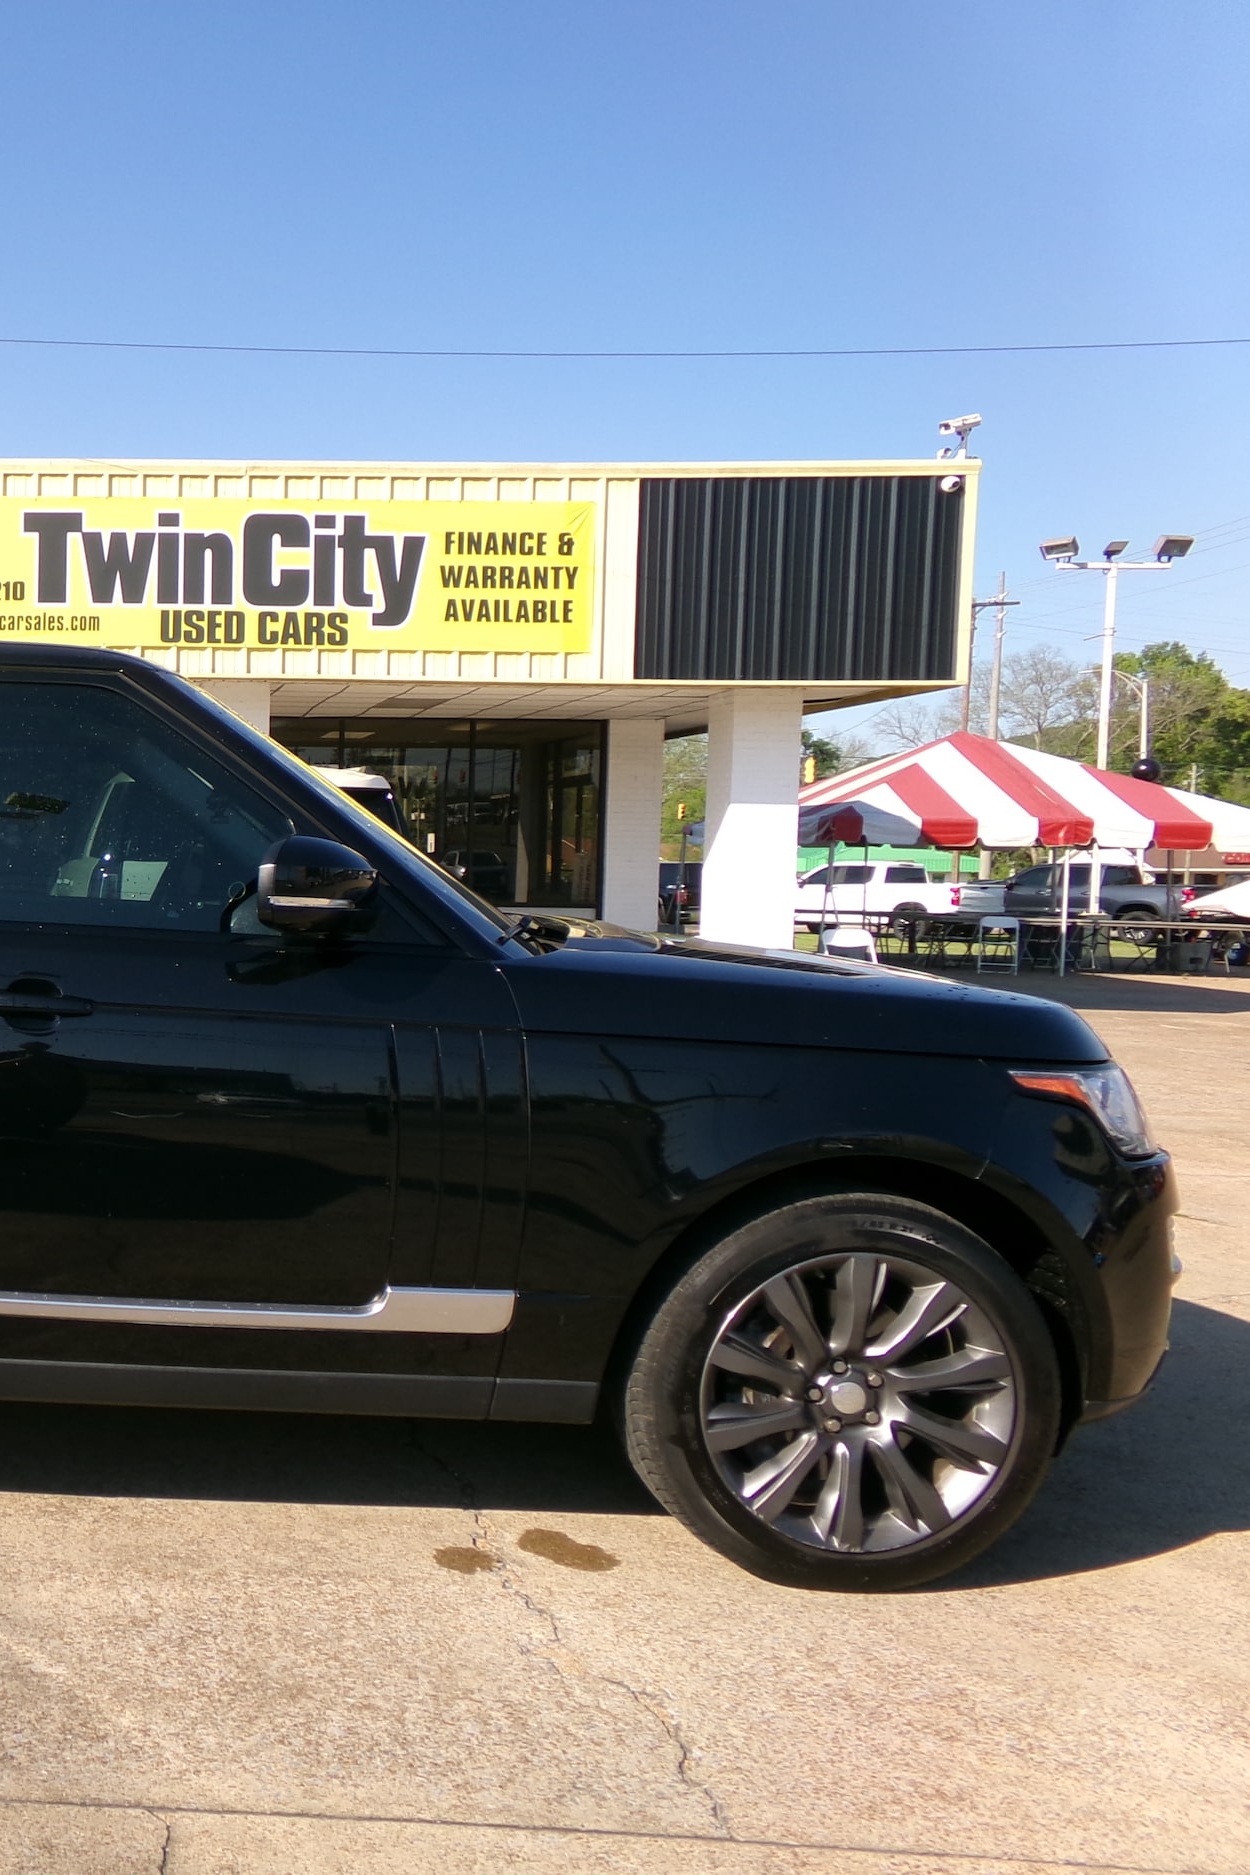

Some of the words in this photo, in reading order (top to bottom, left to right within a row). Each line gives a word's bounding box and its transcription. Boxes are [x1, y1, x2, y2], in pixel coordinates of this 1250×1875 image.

[444, 531, 548, 556] FINANCE
[557, 532, 575, 556] &
[439, 565, 579, 590] WARRANTY
[444, 598, 574, 623] AVAILABLE
[160, 609, 246, 644] USED
[257, 611, 349, 646] CARS
